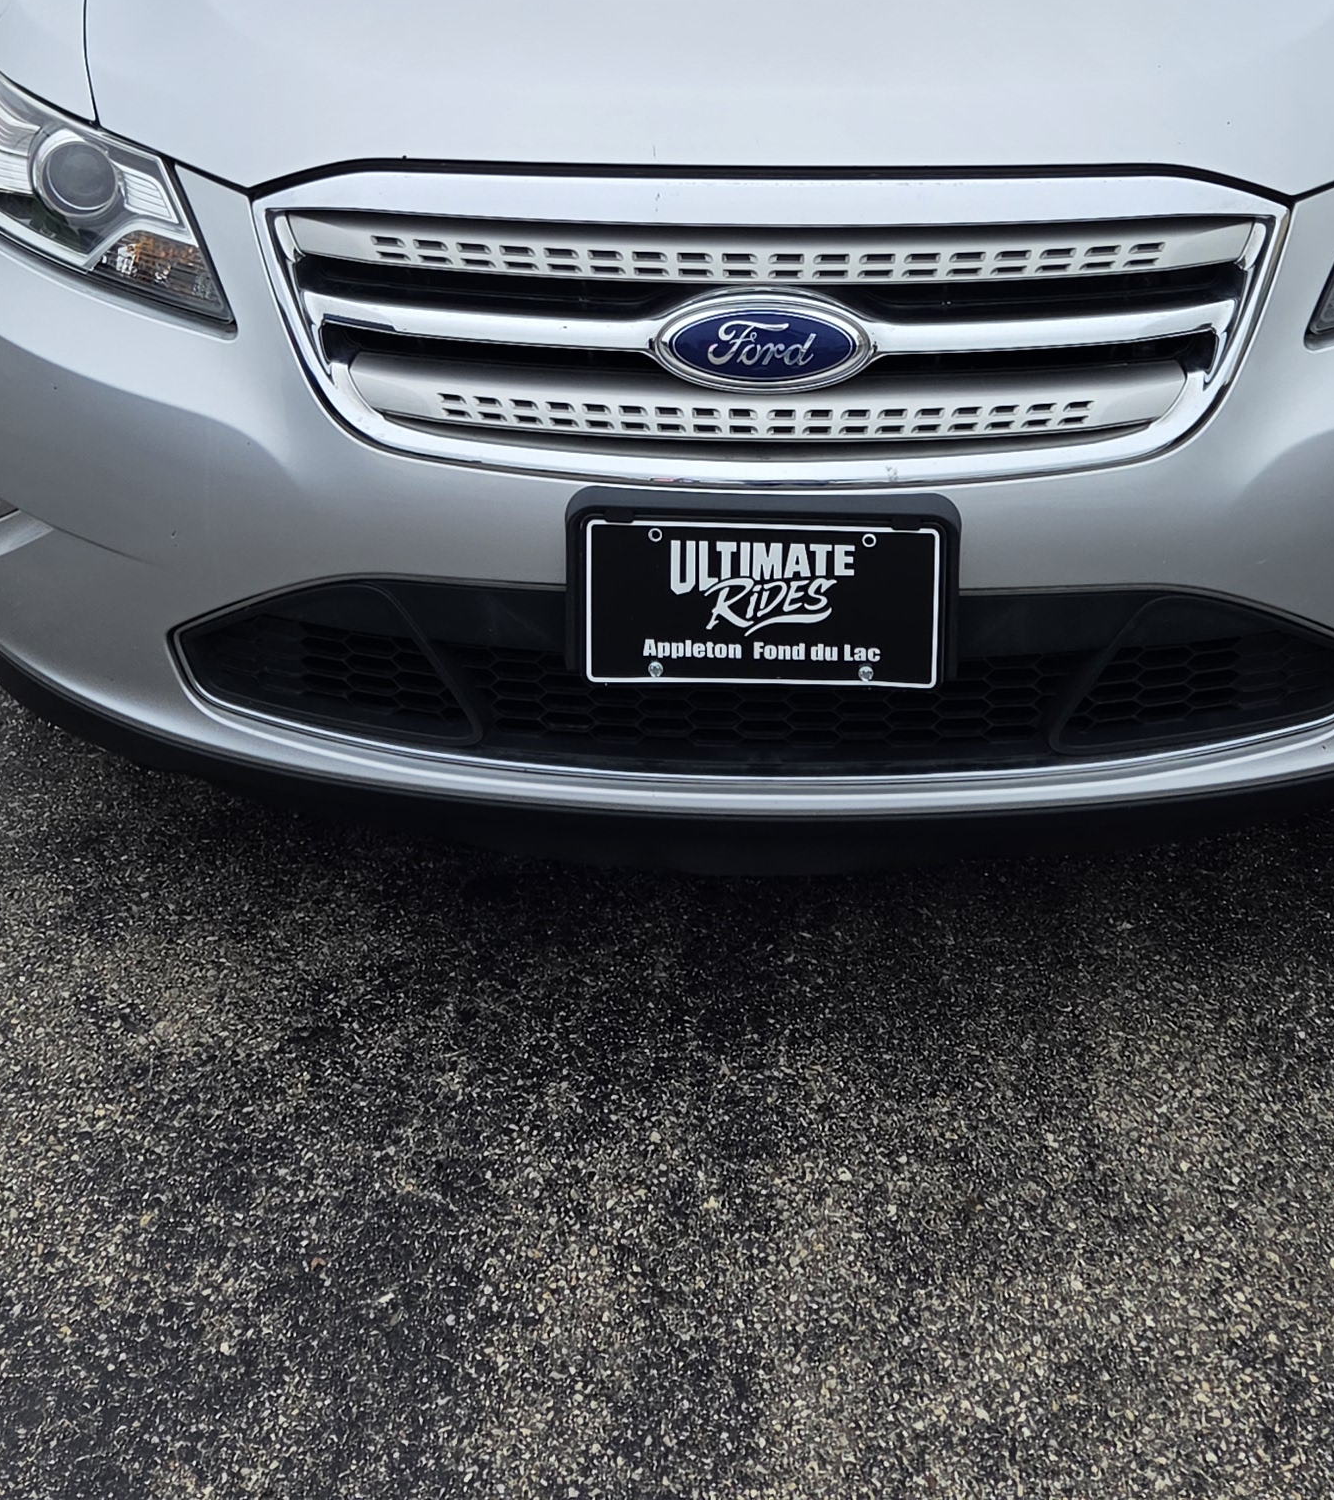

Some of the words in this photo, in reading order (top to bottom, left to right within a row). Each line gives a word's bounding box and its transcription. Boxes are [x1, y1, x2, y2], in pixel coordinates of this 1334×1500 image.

[707, 319, 817, 367] Ford
[670, 540, 856, 595] ULTIMATE
[642, 638, 743, 660] Appleton
[753, 641, 806, 662] Fond
[810, 643, 838, 662] du
[843, 644, 882, 663] Lac
